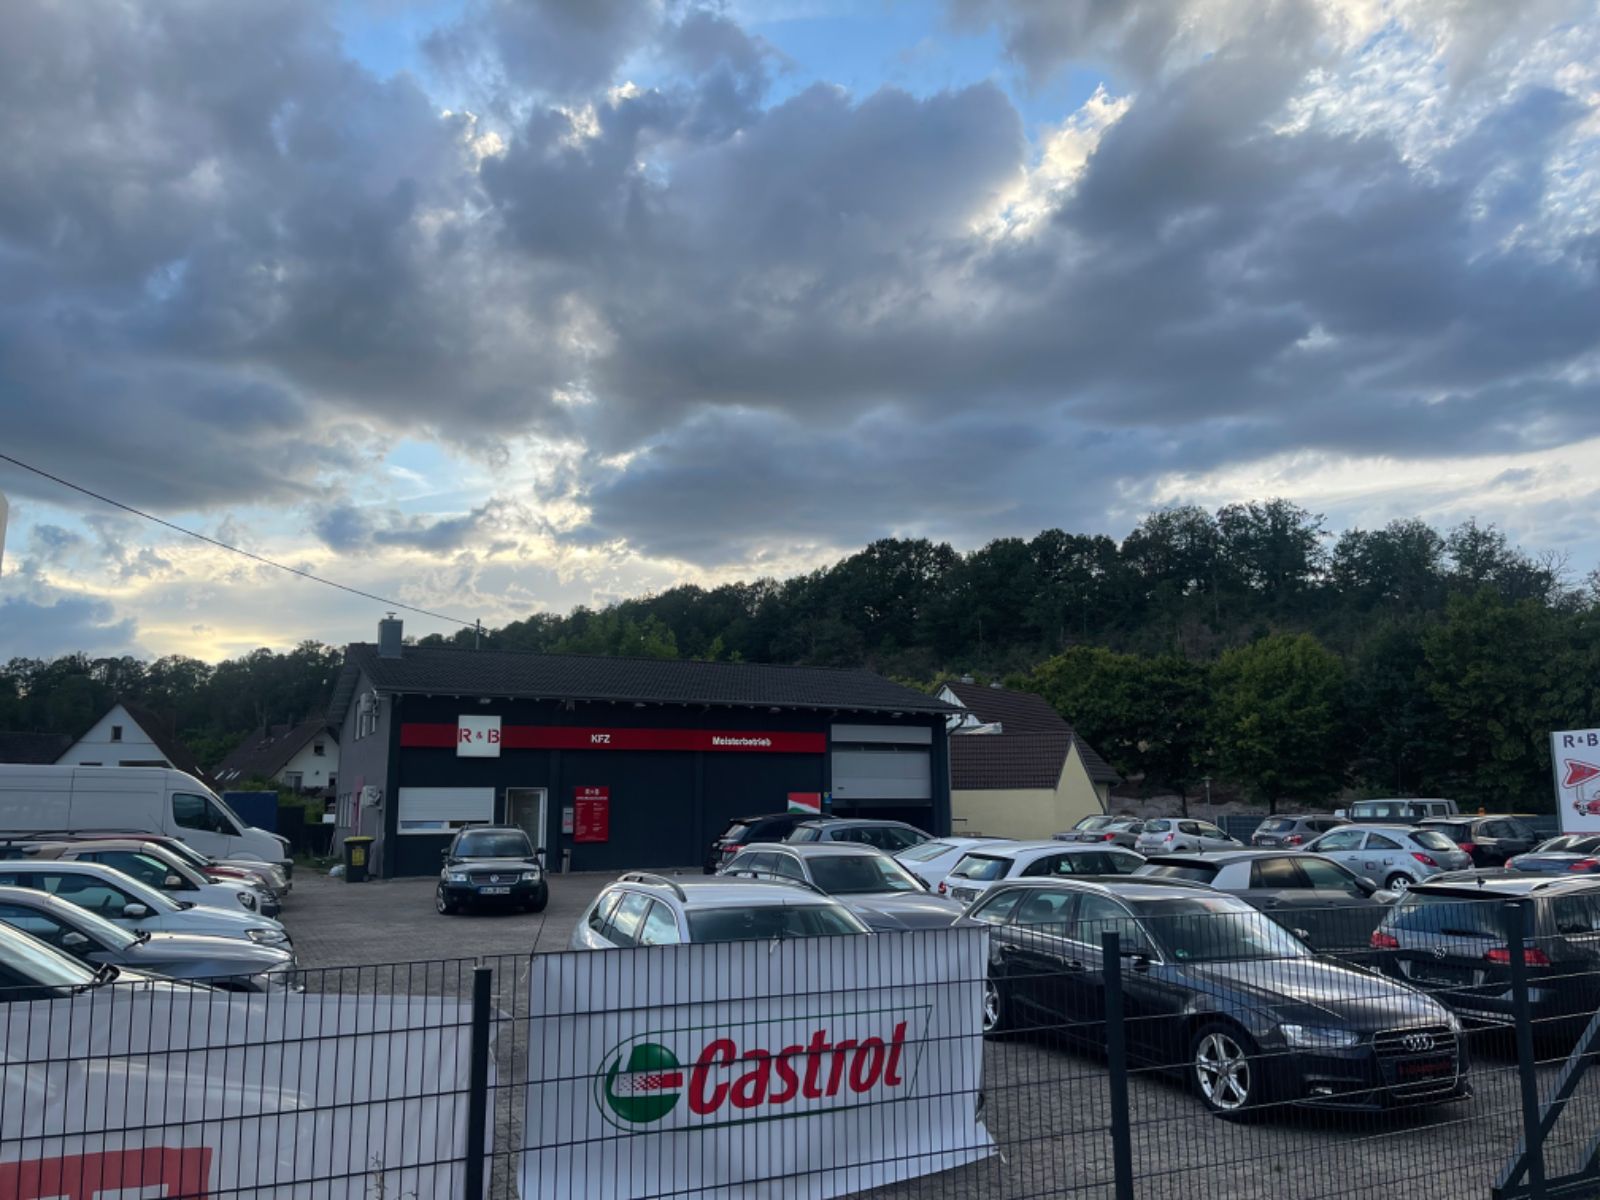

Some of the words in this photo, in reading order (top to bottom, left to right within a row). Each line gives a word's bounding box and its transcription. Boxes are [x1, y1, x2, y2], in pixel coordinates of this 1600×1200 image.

[458, 727, 472, 744] R
[475, 731, 483, 740] &
[487, 728, 500, 744] B
[591, 734, 610, 744] KFZ
[712, 736, 772, 747] Meisterbetrieb
[1563, 734, 1575, 748] R
[1586, 732, 1599, 747] B
[688, 1020, 908, 1115] Castrol
